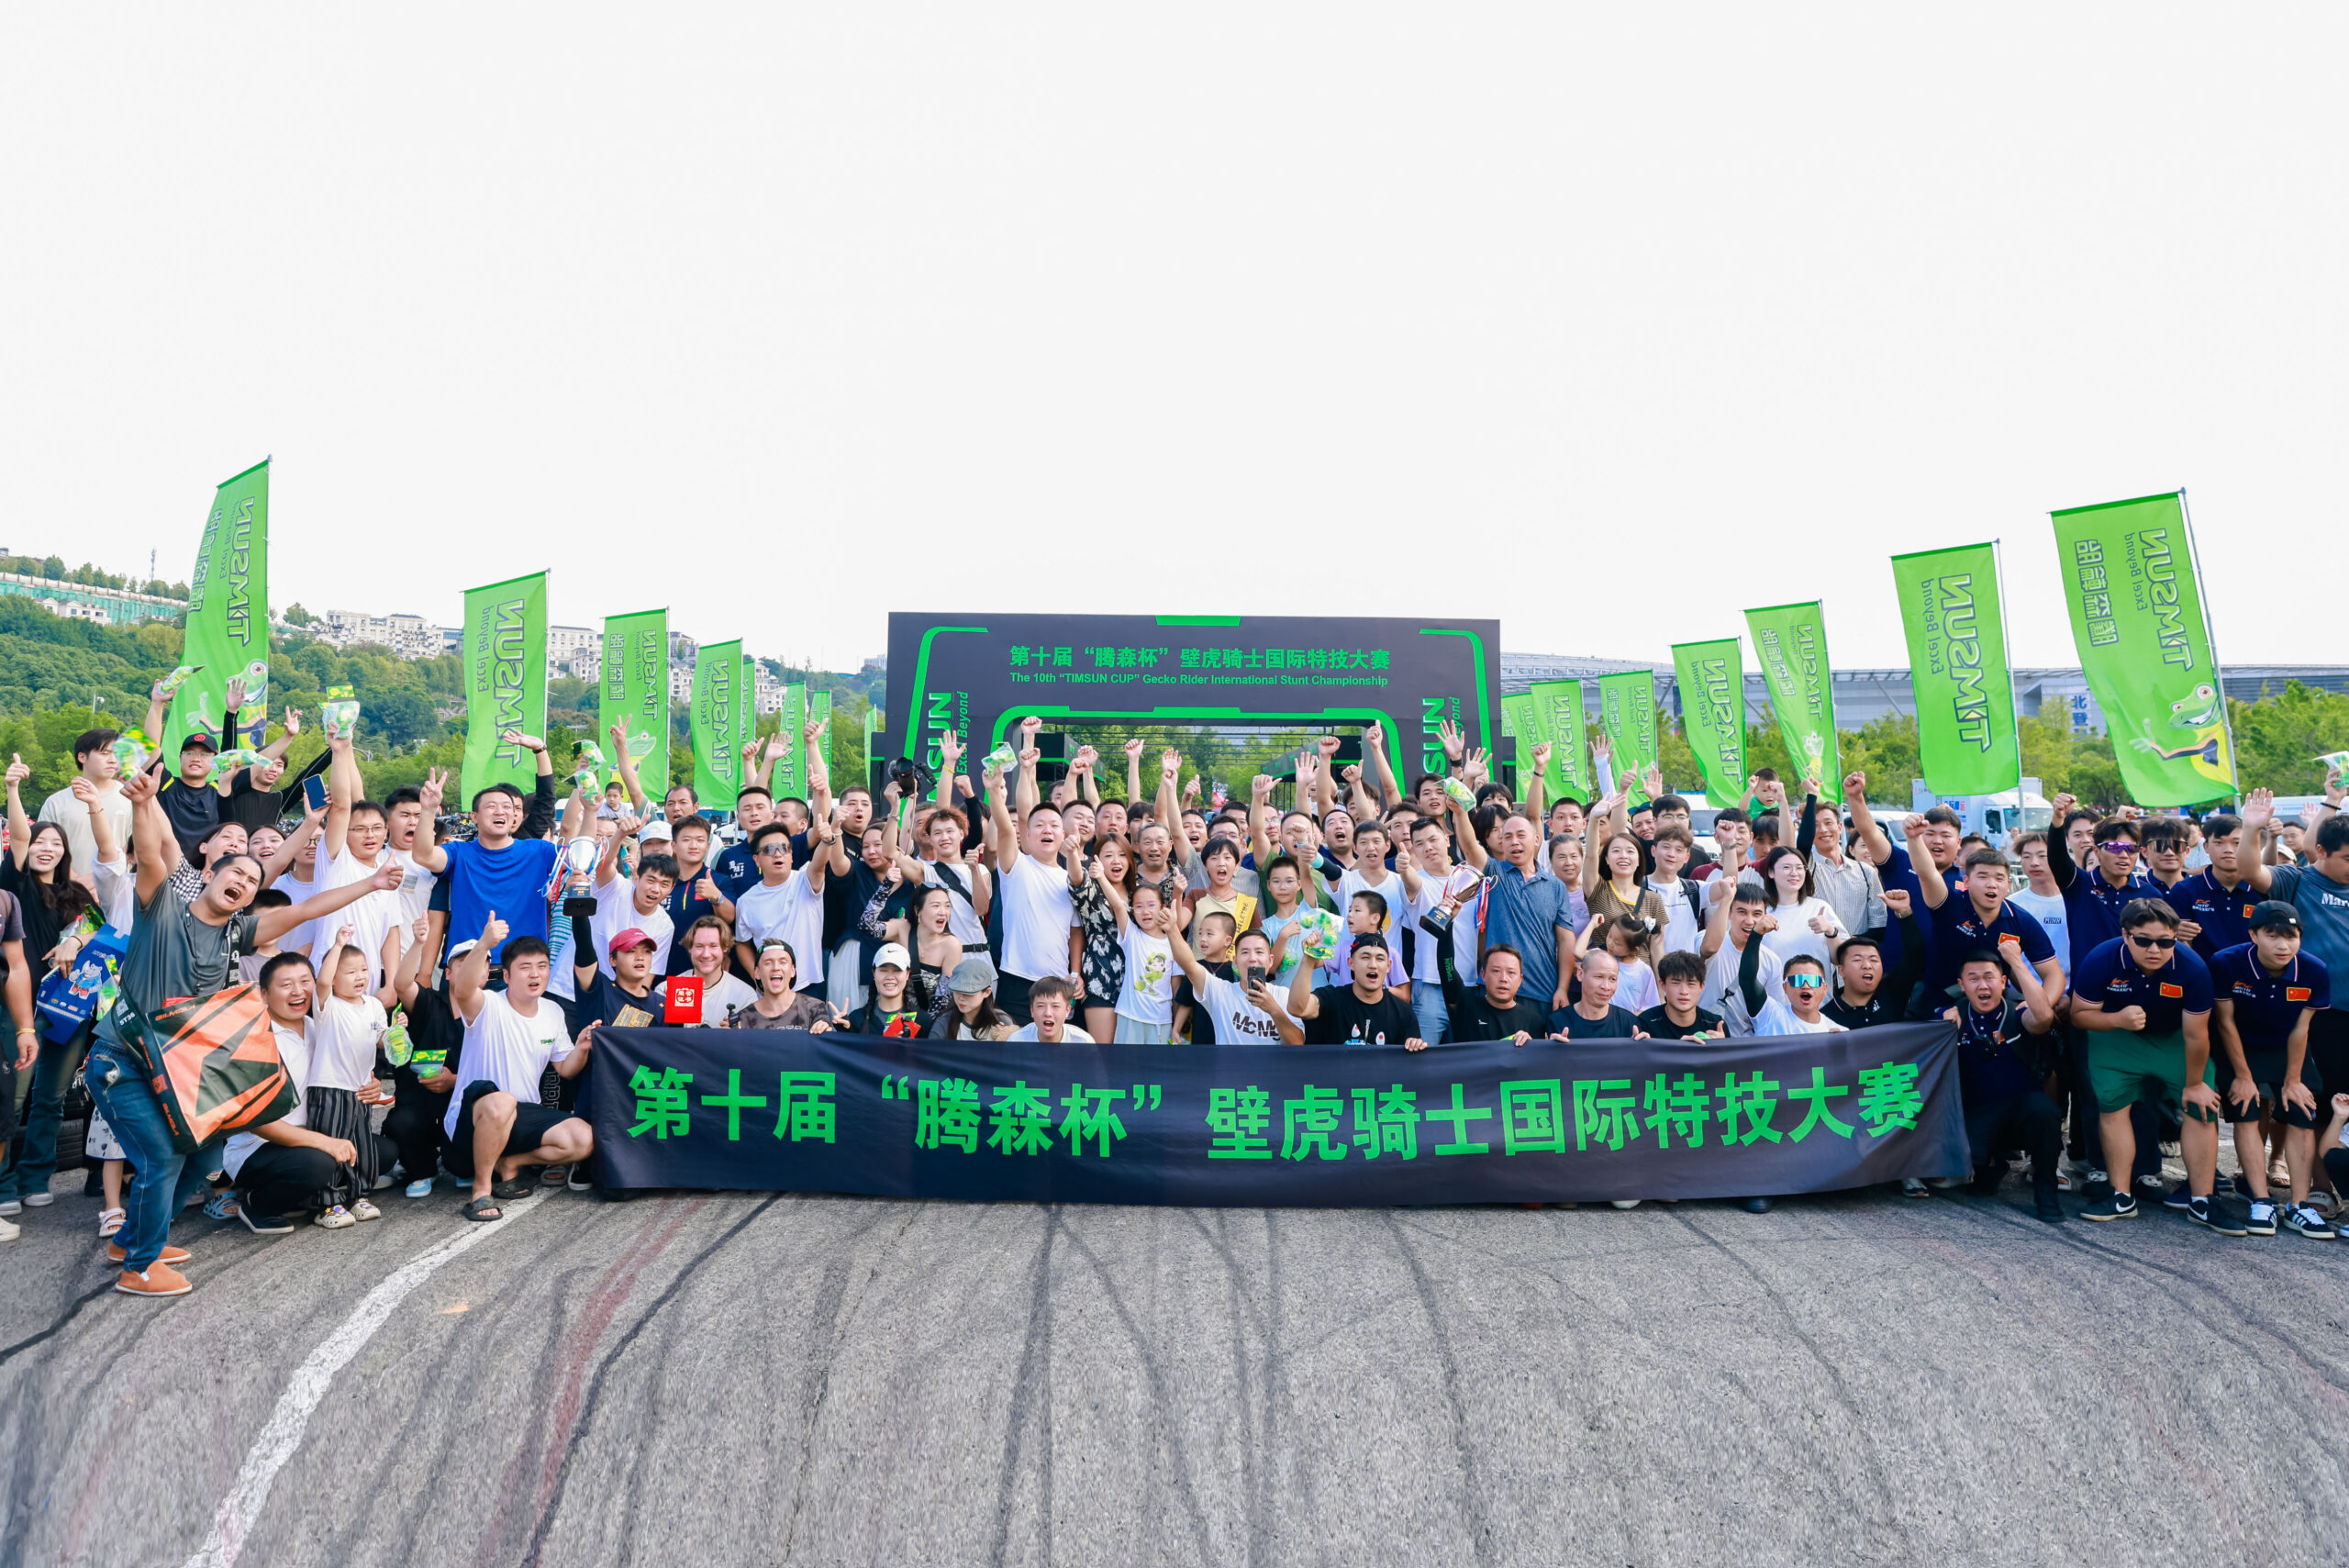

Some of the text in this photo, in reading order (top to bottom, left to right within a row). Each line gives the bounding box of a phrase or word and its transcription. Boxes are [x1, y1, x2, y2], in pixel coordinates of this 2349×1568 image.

[1009, 645, 1390, 670] 第十届 “腾森杯” 壁虎骑士国际特技大赛
[1009, 672, 1030, 683] The
[1033, 673, 1056, 683] 10th
[1059, 673, 1108, 683] “TIMSUN
[1142, 673, 1176, 684] Gecko
[1180, 674, 1209, 684] Rider
[1211, 675, 1277, 684] International
[1280, 675, 1308, 685] Stunt
[1311, 675, 1388, 688] Championship
[957, 691, 971, 738] Beyond
[626, 1064, 837, 1144] 第十届
[881, 1073, 1162, 1159] “腾森杯”
[1204, 1061, 1927, 1162] 壁虎骑士国际特技大赛
